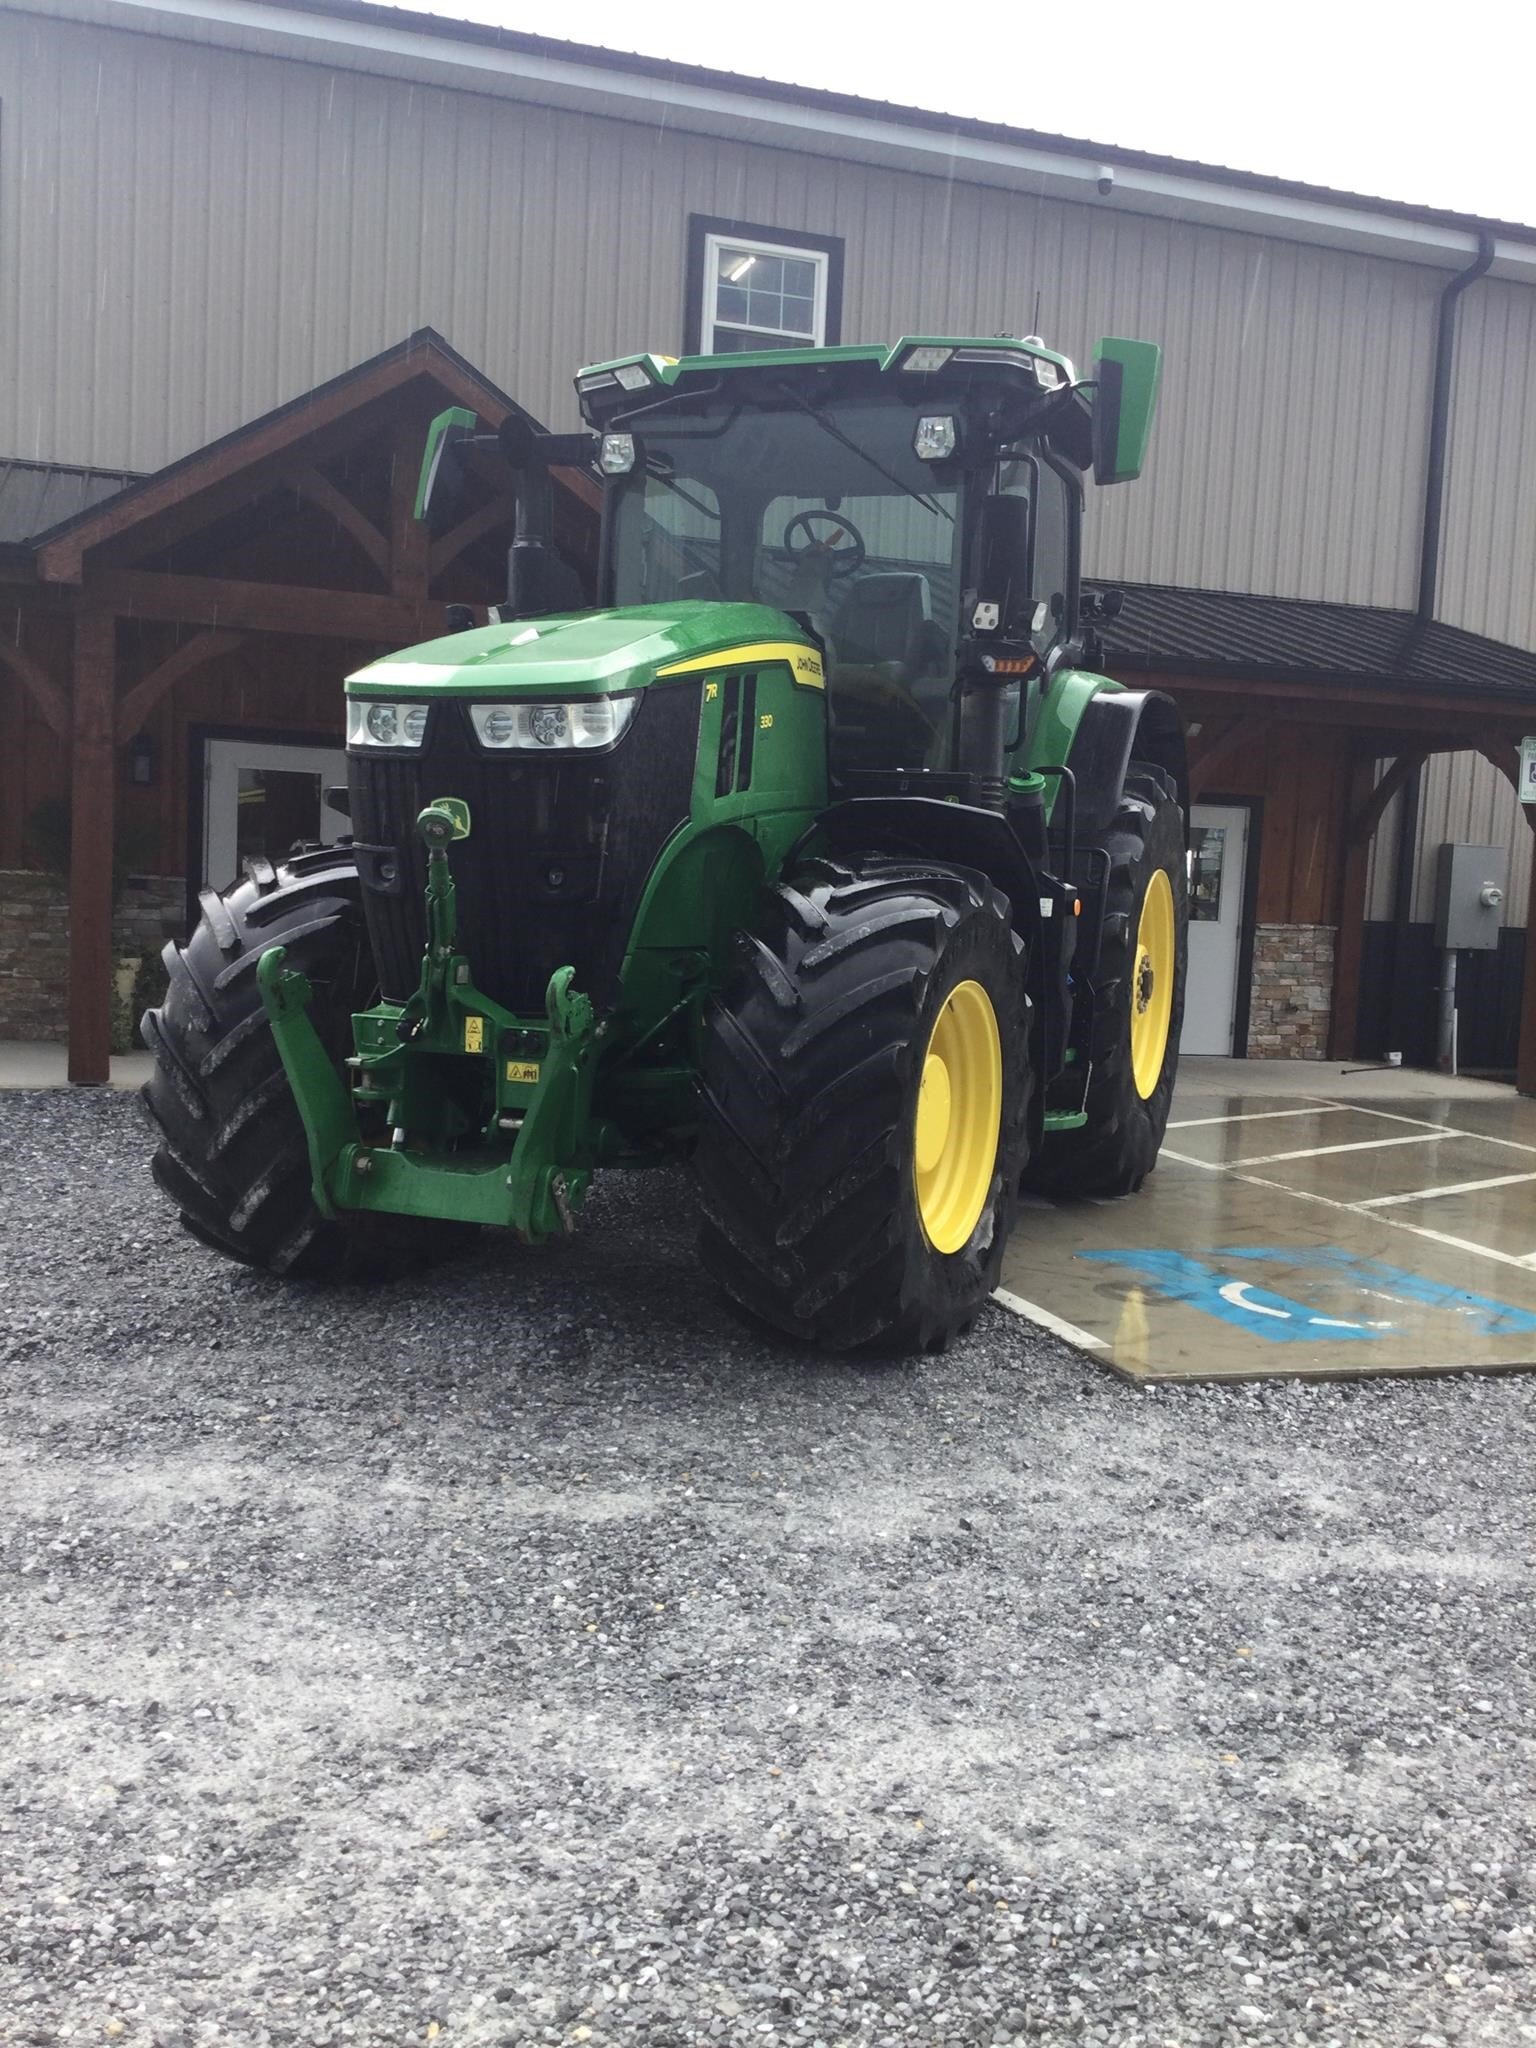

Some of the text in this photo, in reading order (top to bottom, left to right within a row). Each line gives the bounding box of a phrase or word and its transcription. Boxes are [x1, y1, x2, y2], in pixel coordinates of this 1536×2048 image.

[796, 657, 822, 676] JOHN DEERE
[706, 683, 718, 702] 7R
[760, 714, 774, 729] 330
